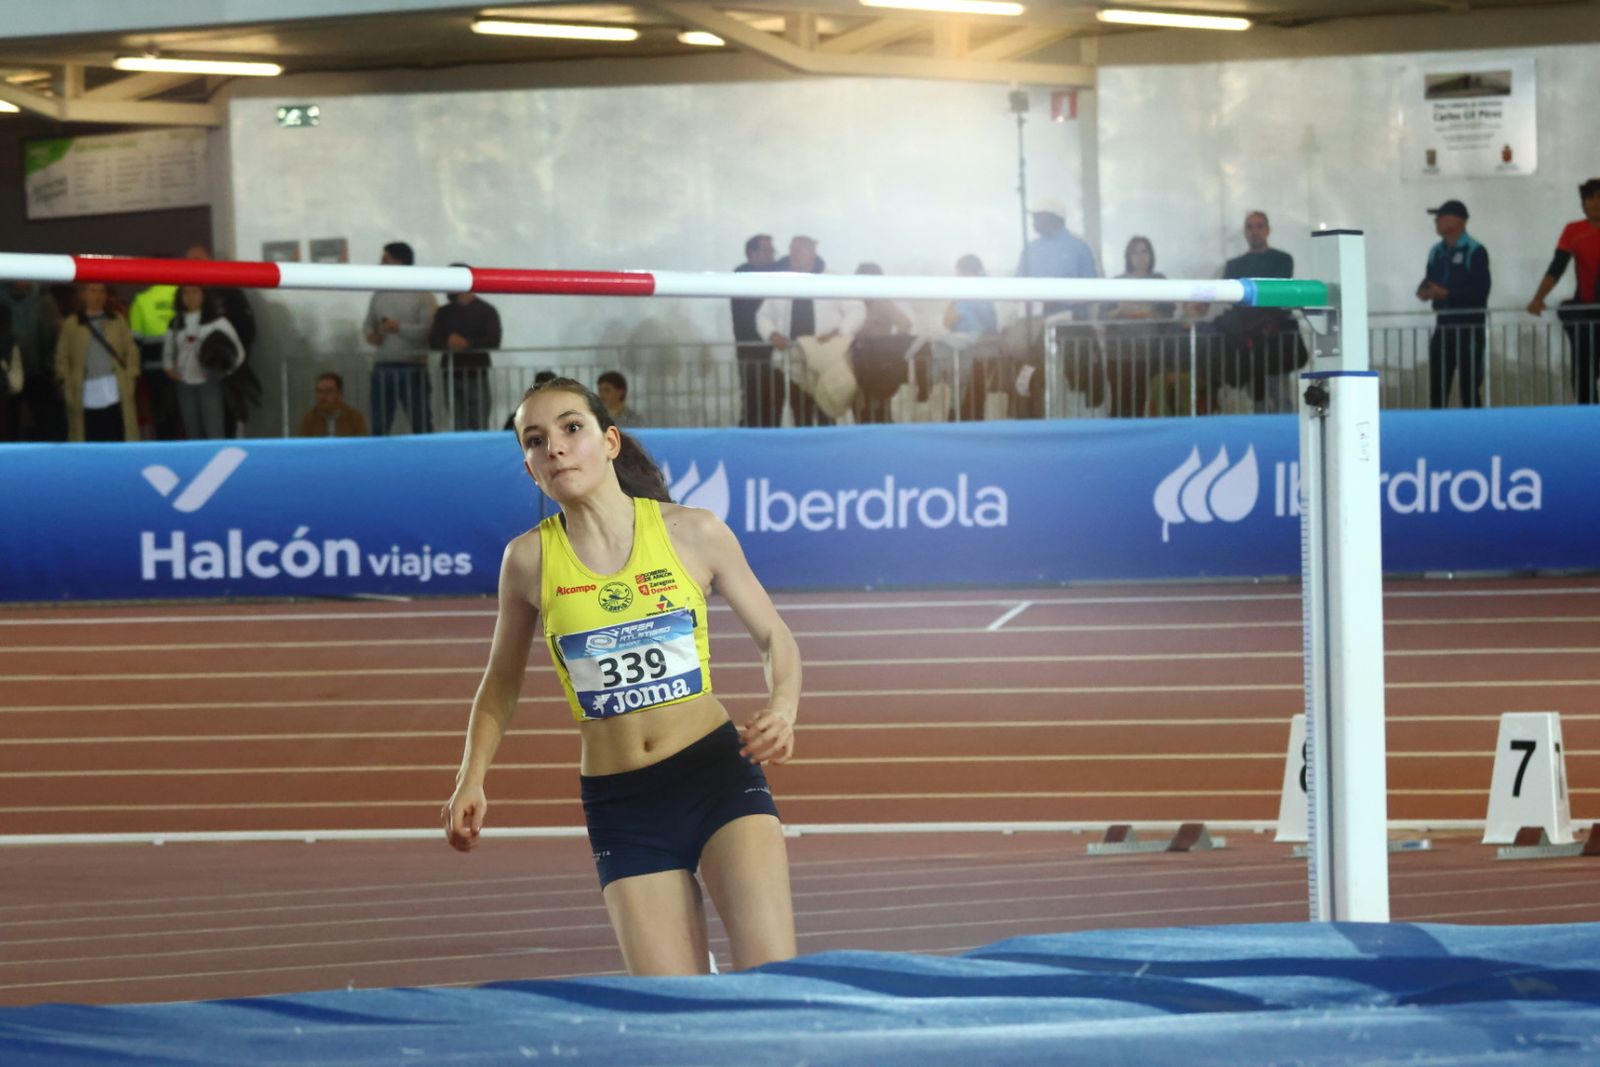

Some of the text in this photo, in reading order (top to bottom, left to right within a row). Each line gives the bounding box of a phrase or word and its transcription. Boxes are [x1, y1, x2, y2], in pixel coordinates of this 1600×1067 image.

[745, 473, 1009, 532] Iberdrola
[141, 525, 473, 582] Halcón viajes
[556, 584, 597, 596] Alcampo
[598, 648, 668, 688] 339
[1510, 740, 1537, 798] 7
